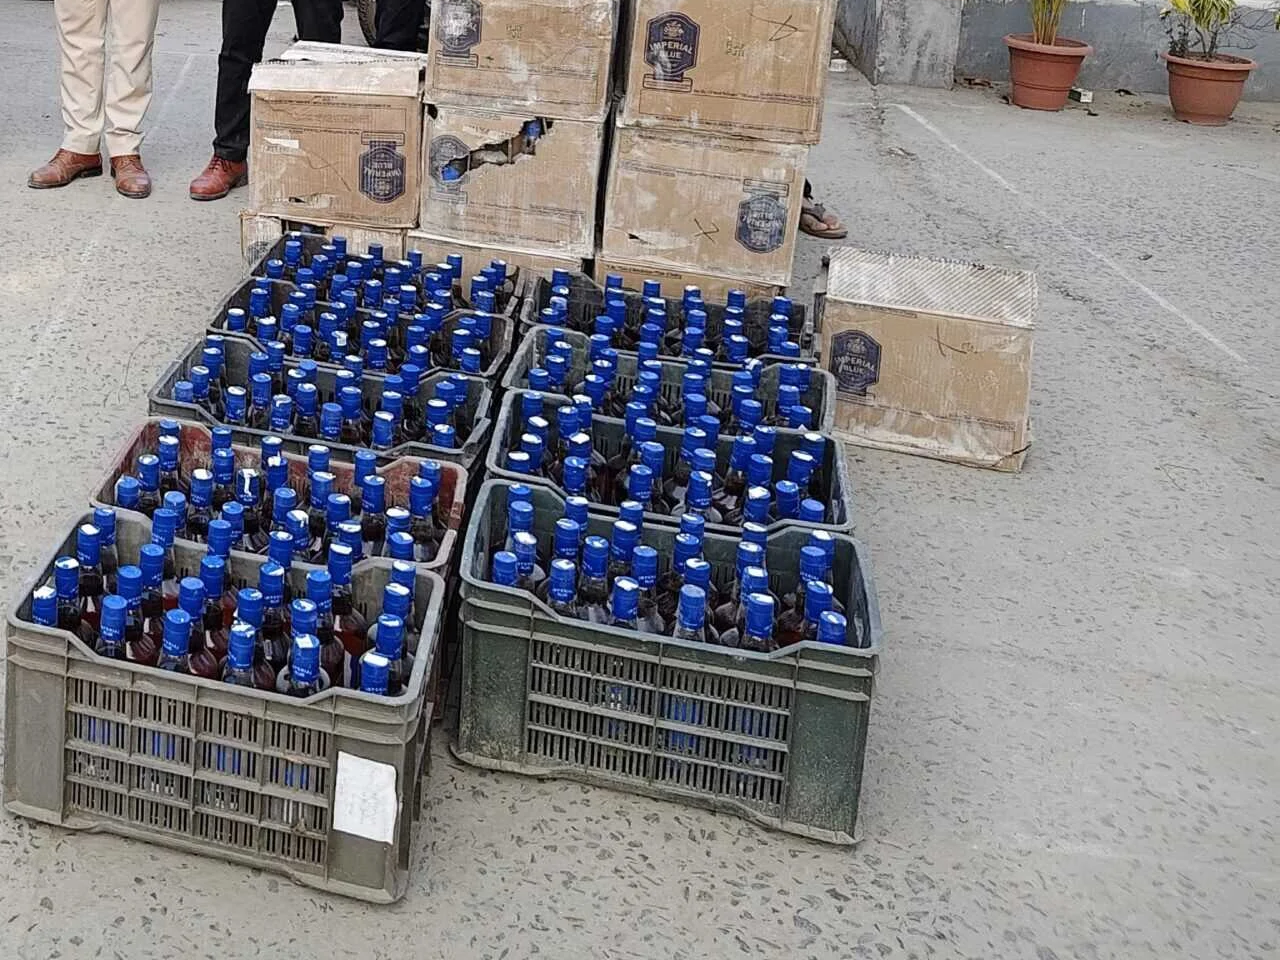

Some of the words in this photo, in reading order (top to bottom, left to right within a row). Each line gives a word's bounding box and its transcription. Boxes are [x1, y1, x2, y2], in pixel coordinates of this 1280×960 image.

[649, 41, 694, 55] IMPERIAL
[659, 50, 683, 59] BLUE
[833, 355, 876, 372] IMPERIAL
[843, 364, 865, 374] BLUE
